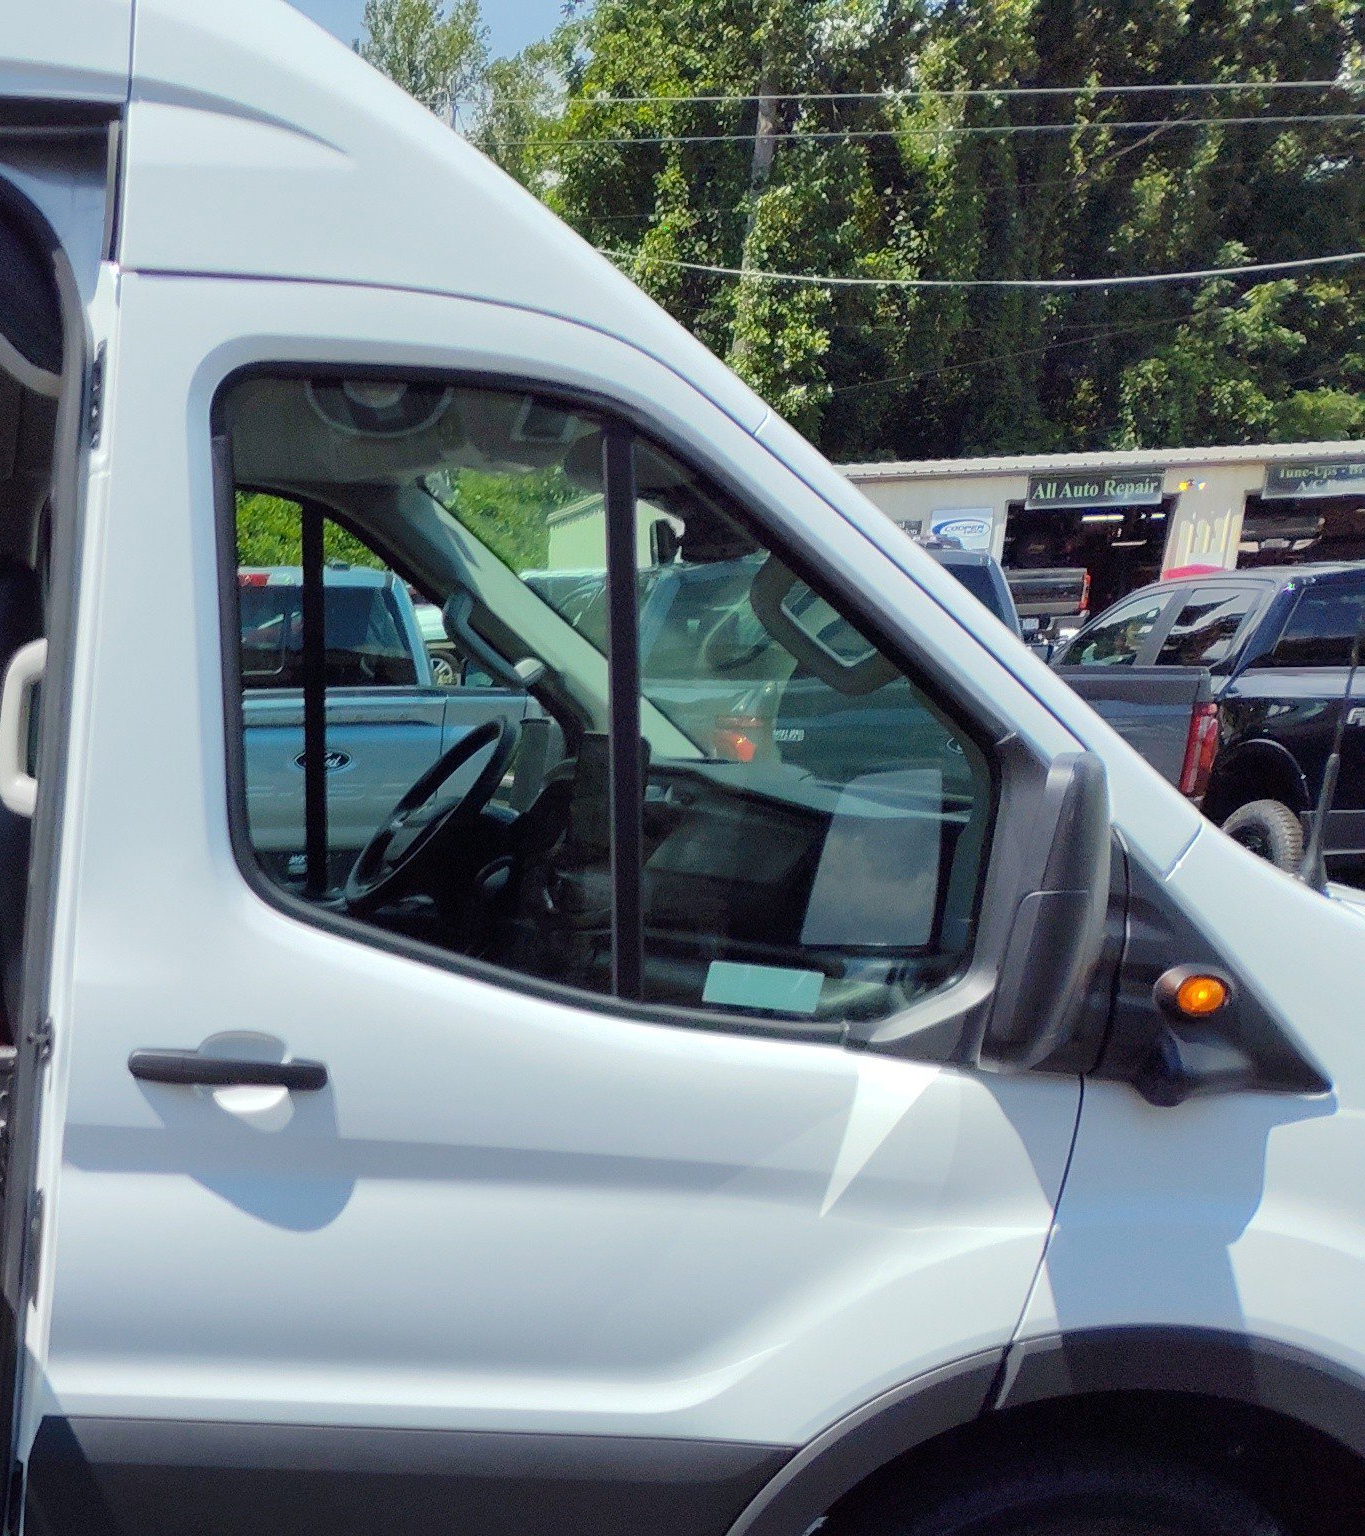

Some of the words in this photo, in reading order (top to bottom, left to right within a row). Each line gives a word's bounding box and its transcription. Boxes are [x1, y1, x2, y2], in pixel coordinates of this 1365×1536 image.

[1032, 482, 1057, 499] All
[1059, 481, 1099, 498] Auto
[1103, 478, 1159, 500] Repair
[944, 523, 984, 532] COOPER
